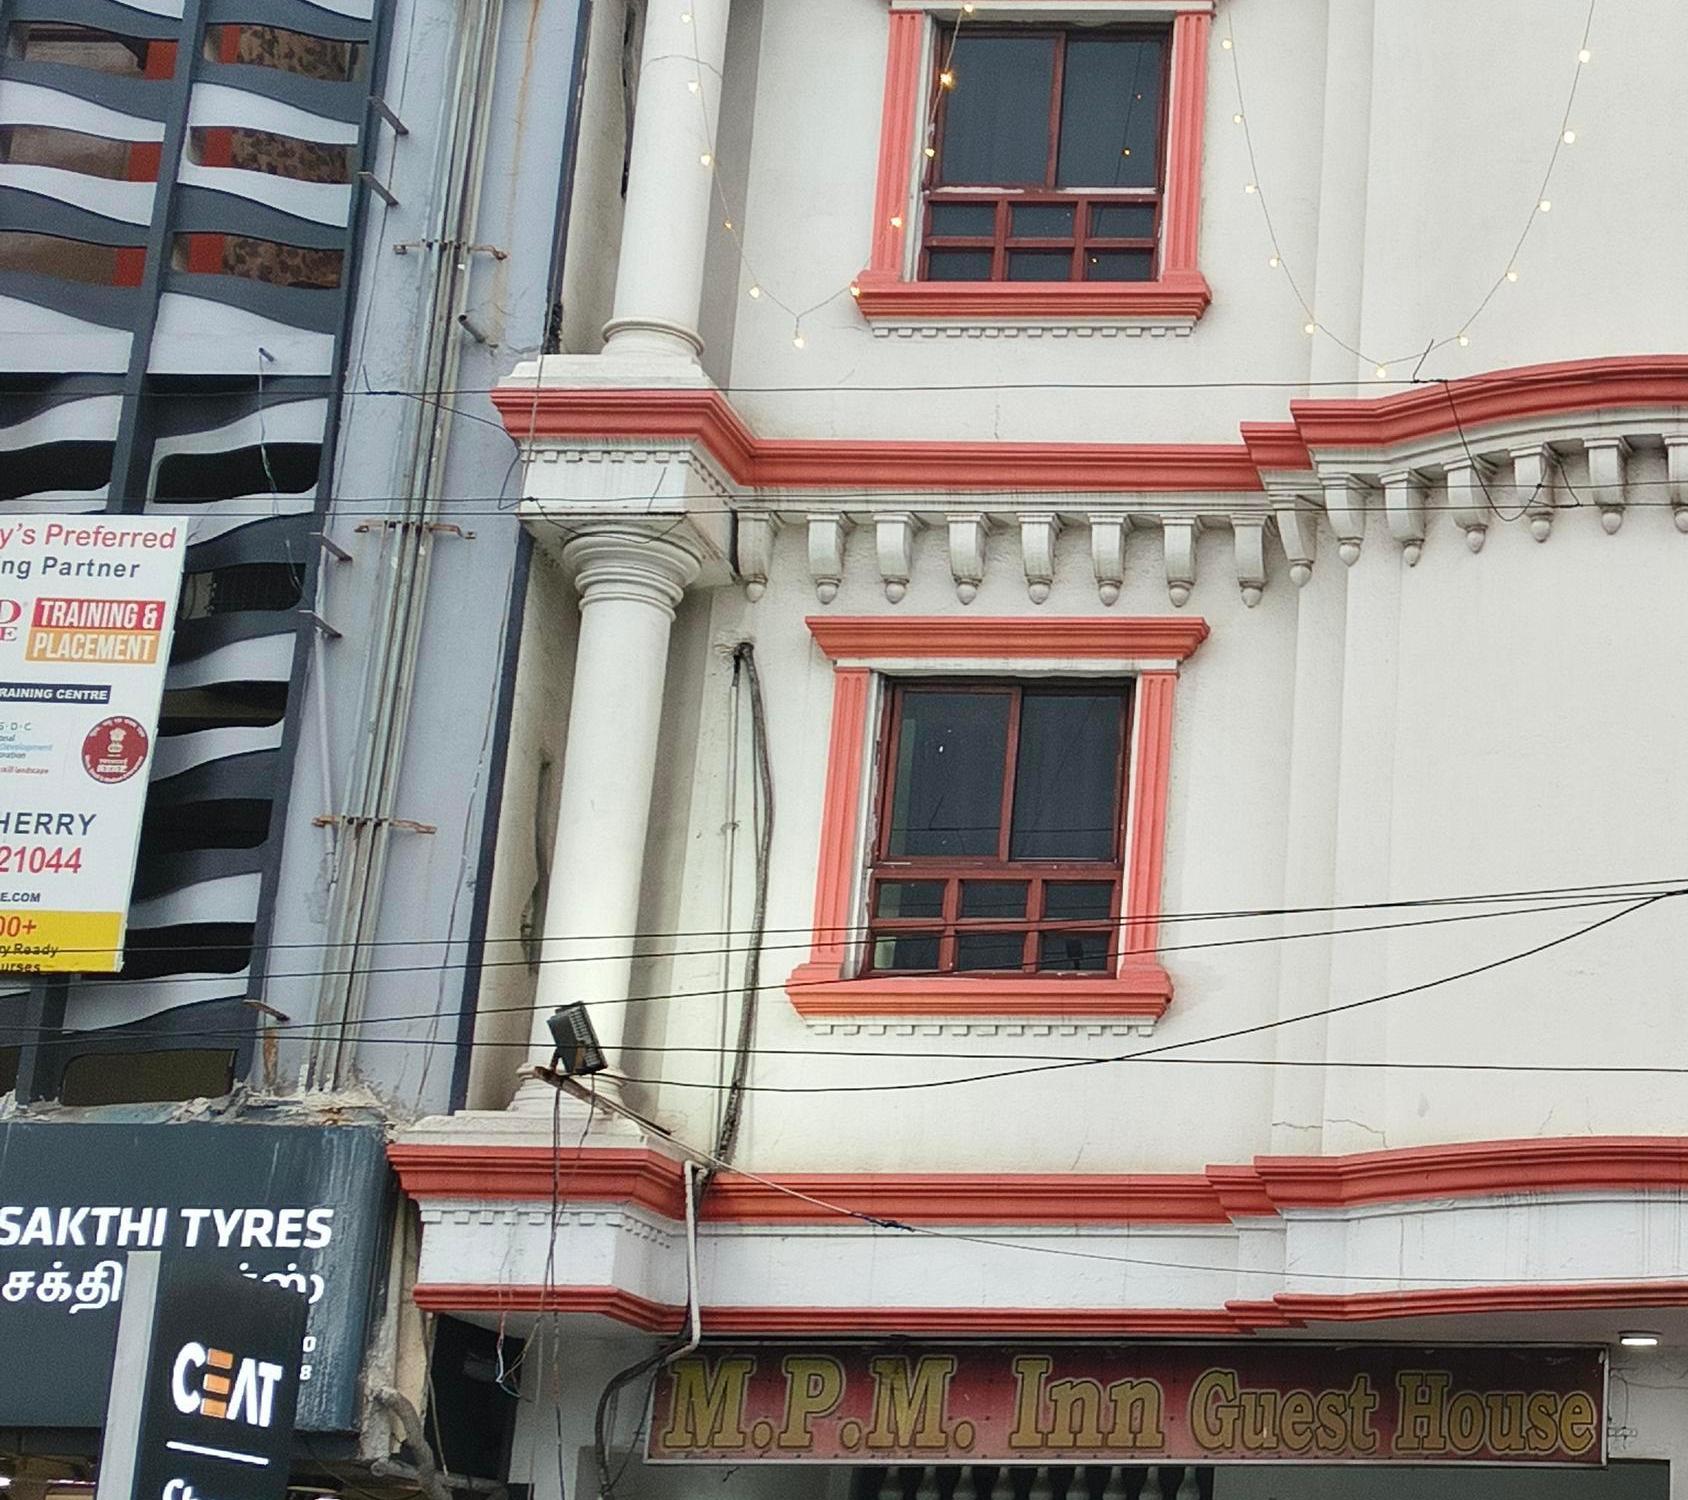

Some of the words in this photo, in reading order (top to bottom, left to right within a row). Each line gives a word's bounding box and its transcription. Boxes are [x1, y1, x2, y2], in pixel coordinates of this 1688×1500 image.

[44, 523, 177, 549] Preferred
[42, 556, 140, 578] Partner
[40, 601, 138, 629] TRAINING
[142, 603, 158, 629] &
[32, 631, 155, 661] PLACEMENT
[56, 689, 108, 701] CENTRE
[0, 846, 82, 874] 21044
[13, 943, 58, 958] Ready
[0, 1206, 168, 1247] SAKTHI
[180, 1208, 335, 1250] TYRES
[2, 1258, 124, 1314] சக்தி
[171, 1341, 283, 1428] CEAT
[664, 1355, 976, 1451] M.P.M.
[1010, 1357, 1166, 1452] Inn
[1190, 1369, 1378, 1455] Guest
[1394, 1372, 1598, 1456] House
